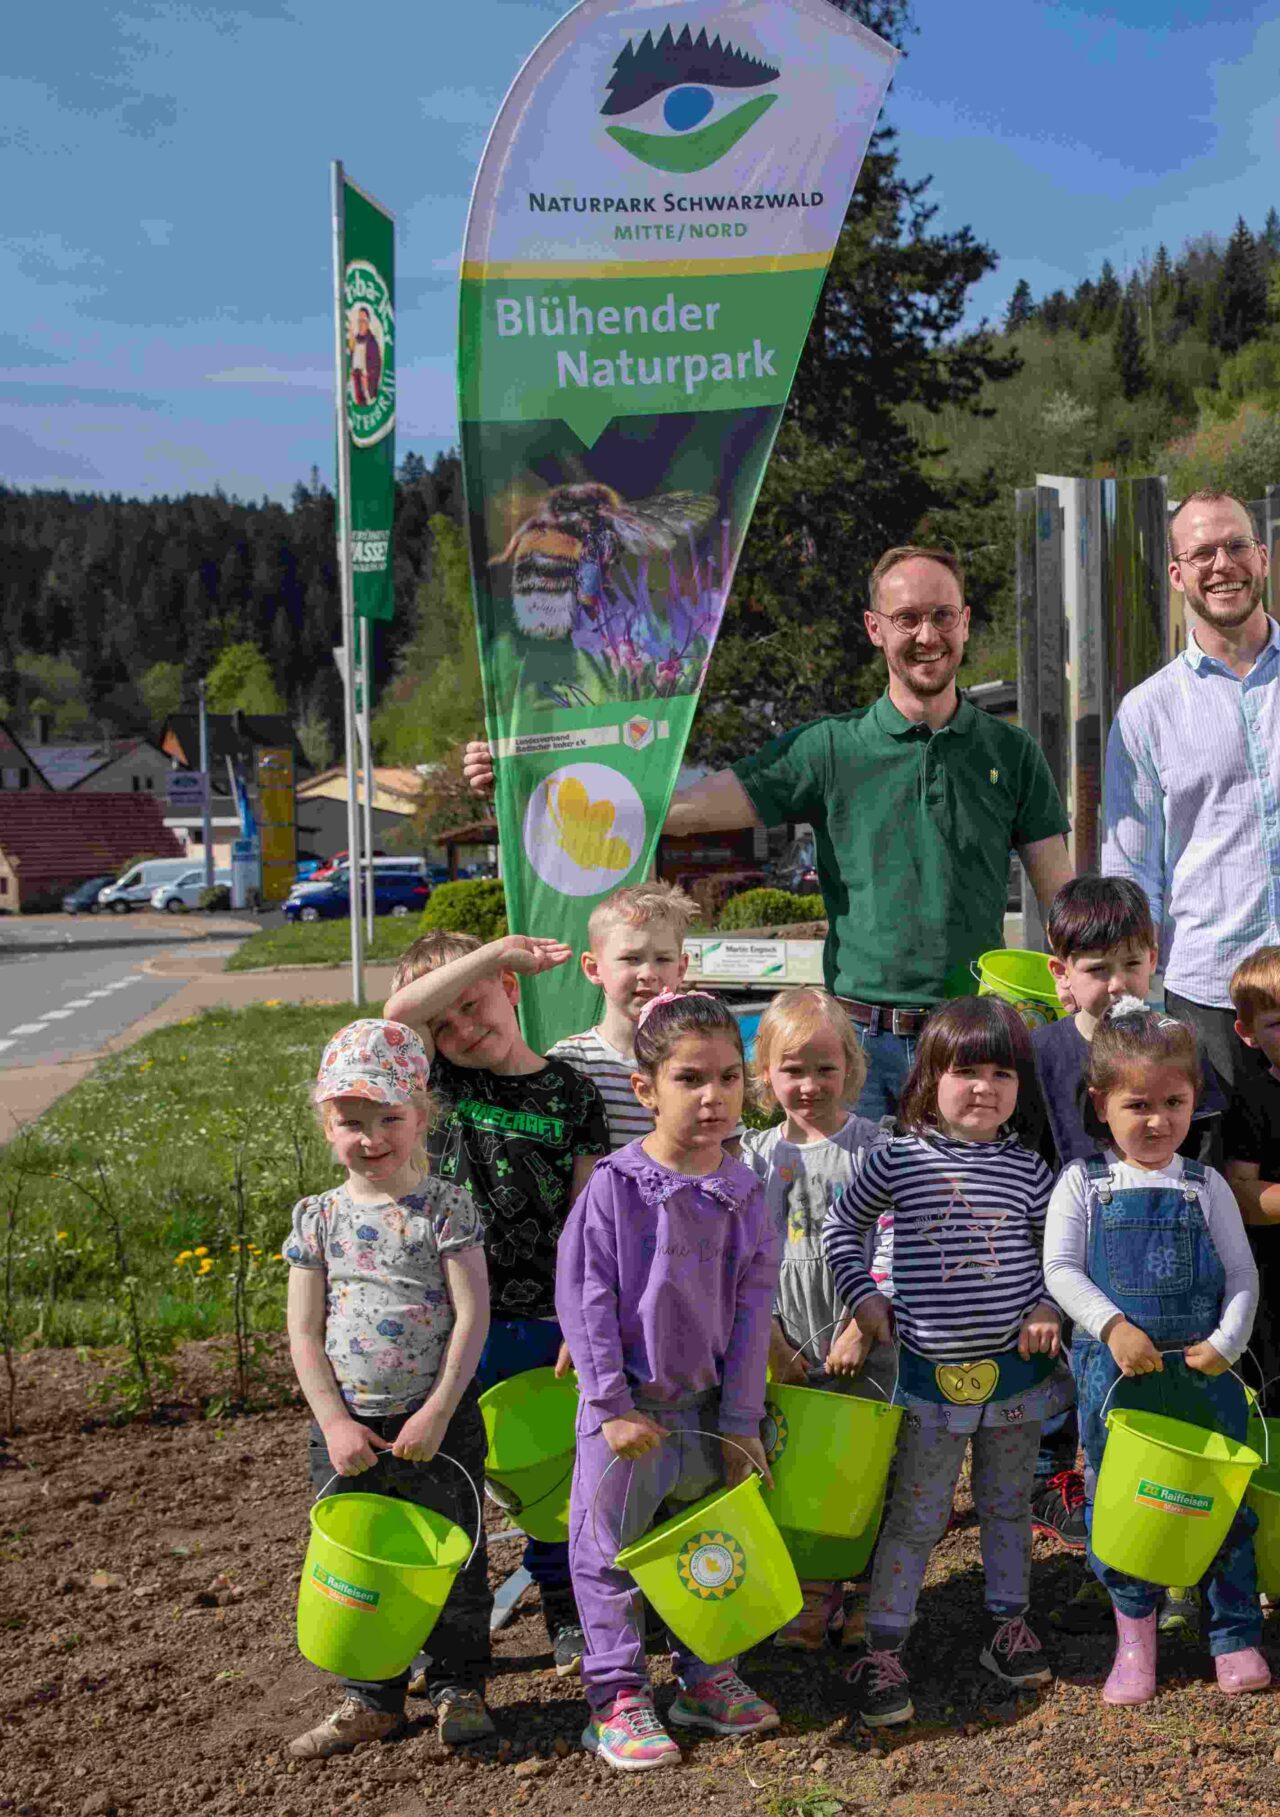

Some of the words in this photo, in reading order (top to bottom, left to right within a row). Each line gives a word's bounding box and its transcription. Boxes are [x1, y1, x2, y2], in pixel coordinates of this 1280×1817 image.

[613, 222, 747, 242] MITTE/NORD
[496, 293, 720, 337] Blühender
[557, 339, 777, 393] Naturpark
[458, 1098, 564, 1138] MINECRAFT
[1160, 1490, 1209, 1507] Raiffeisen
[327, 1575, 374, 1601] Raiffeisen
